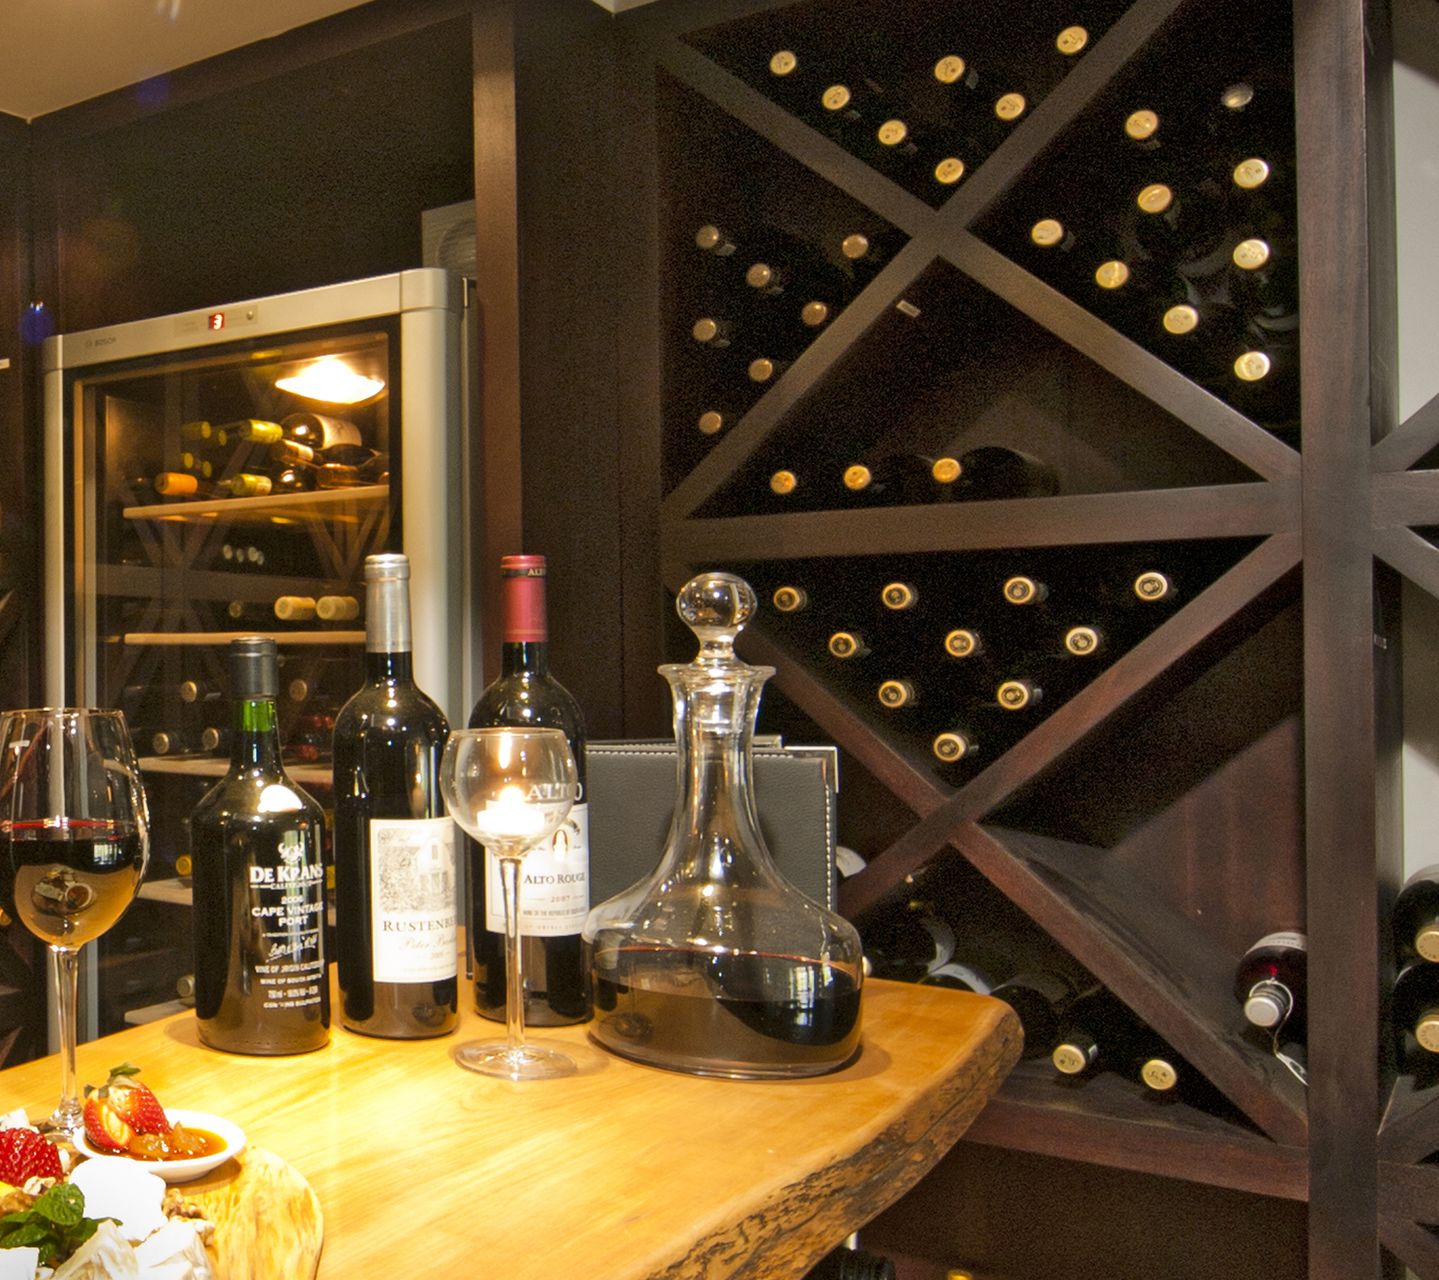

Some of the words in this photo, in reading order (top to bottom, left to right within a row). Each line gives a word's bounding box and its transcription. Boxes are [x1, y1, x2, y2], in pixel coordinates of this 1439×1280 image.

[249, 866, 275, 883] DE
[276, 863, 324, 883] KRANS
[523, 874, 555, 885] ALTO
[251, 906, 285, 917] CAPE
[286, 901, 324, 915] VINTAGE
[278, 915, 309, 927] PORT
